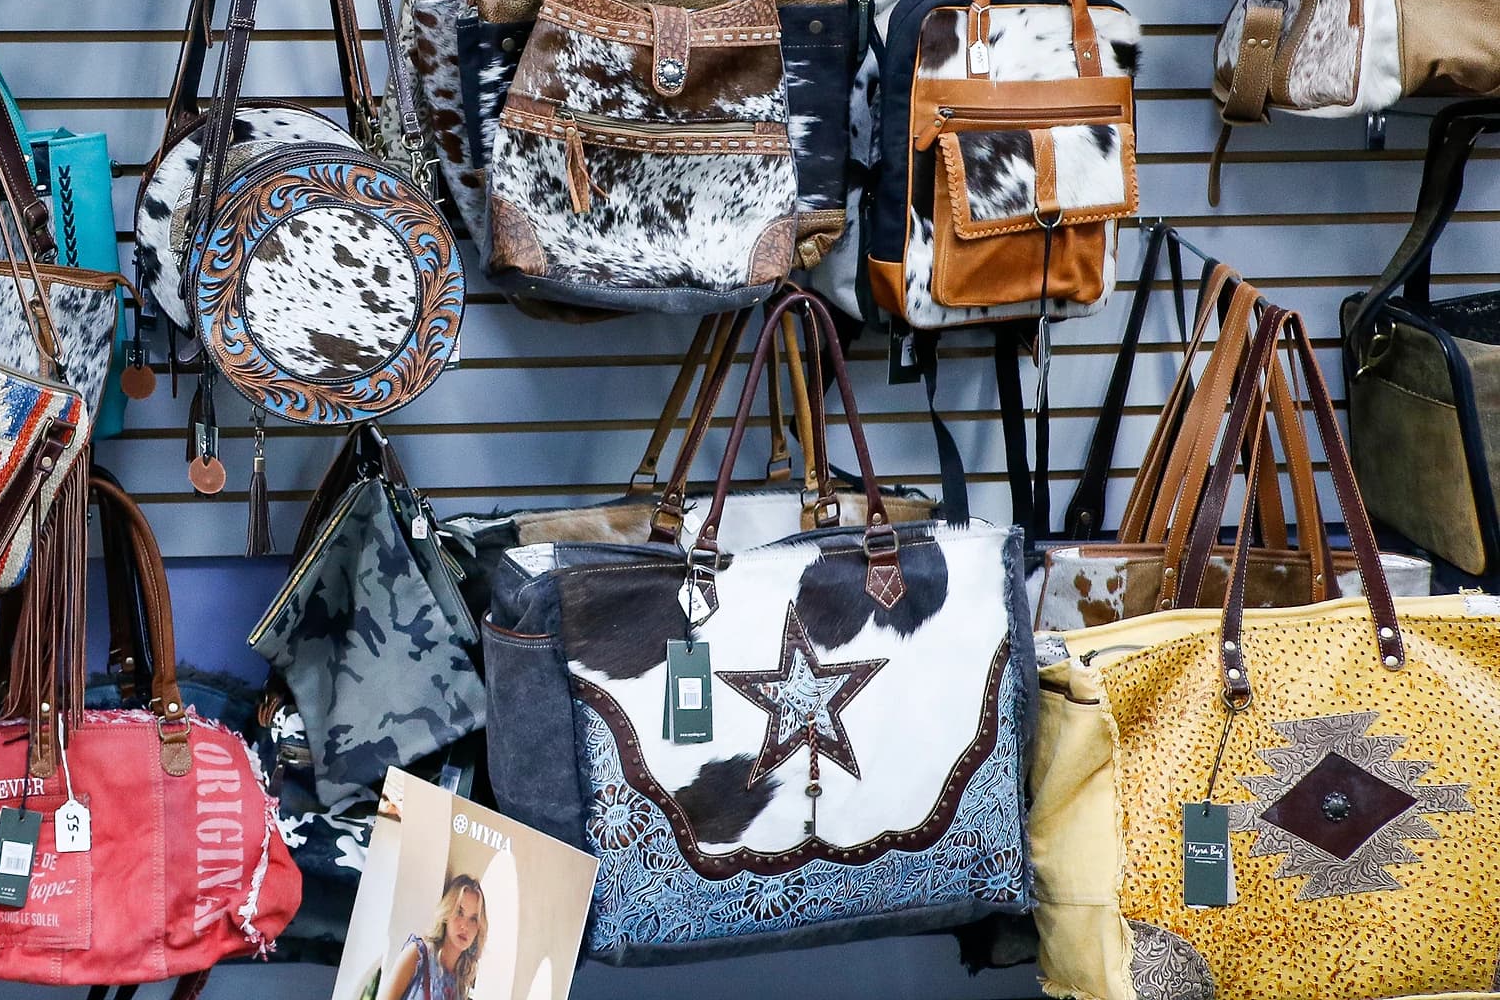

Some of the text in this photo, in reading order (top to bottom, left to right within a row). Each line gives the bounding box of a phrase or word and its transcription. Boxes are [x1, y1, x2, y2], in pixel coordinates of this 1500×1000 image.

[468, 821, 513, 856] MYRA
[1188, 844, 1224, 858] Myra Bag
[20, 912, 30, 925] LE
[31, 912, 60, 928] SOLEIL
